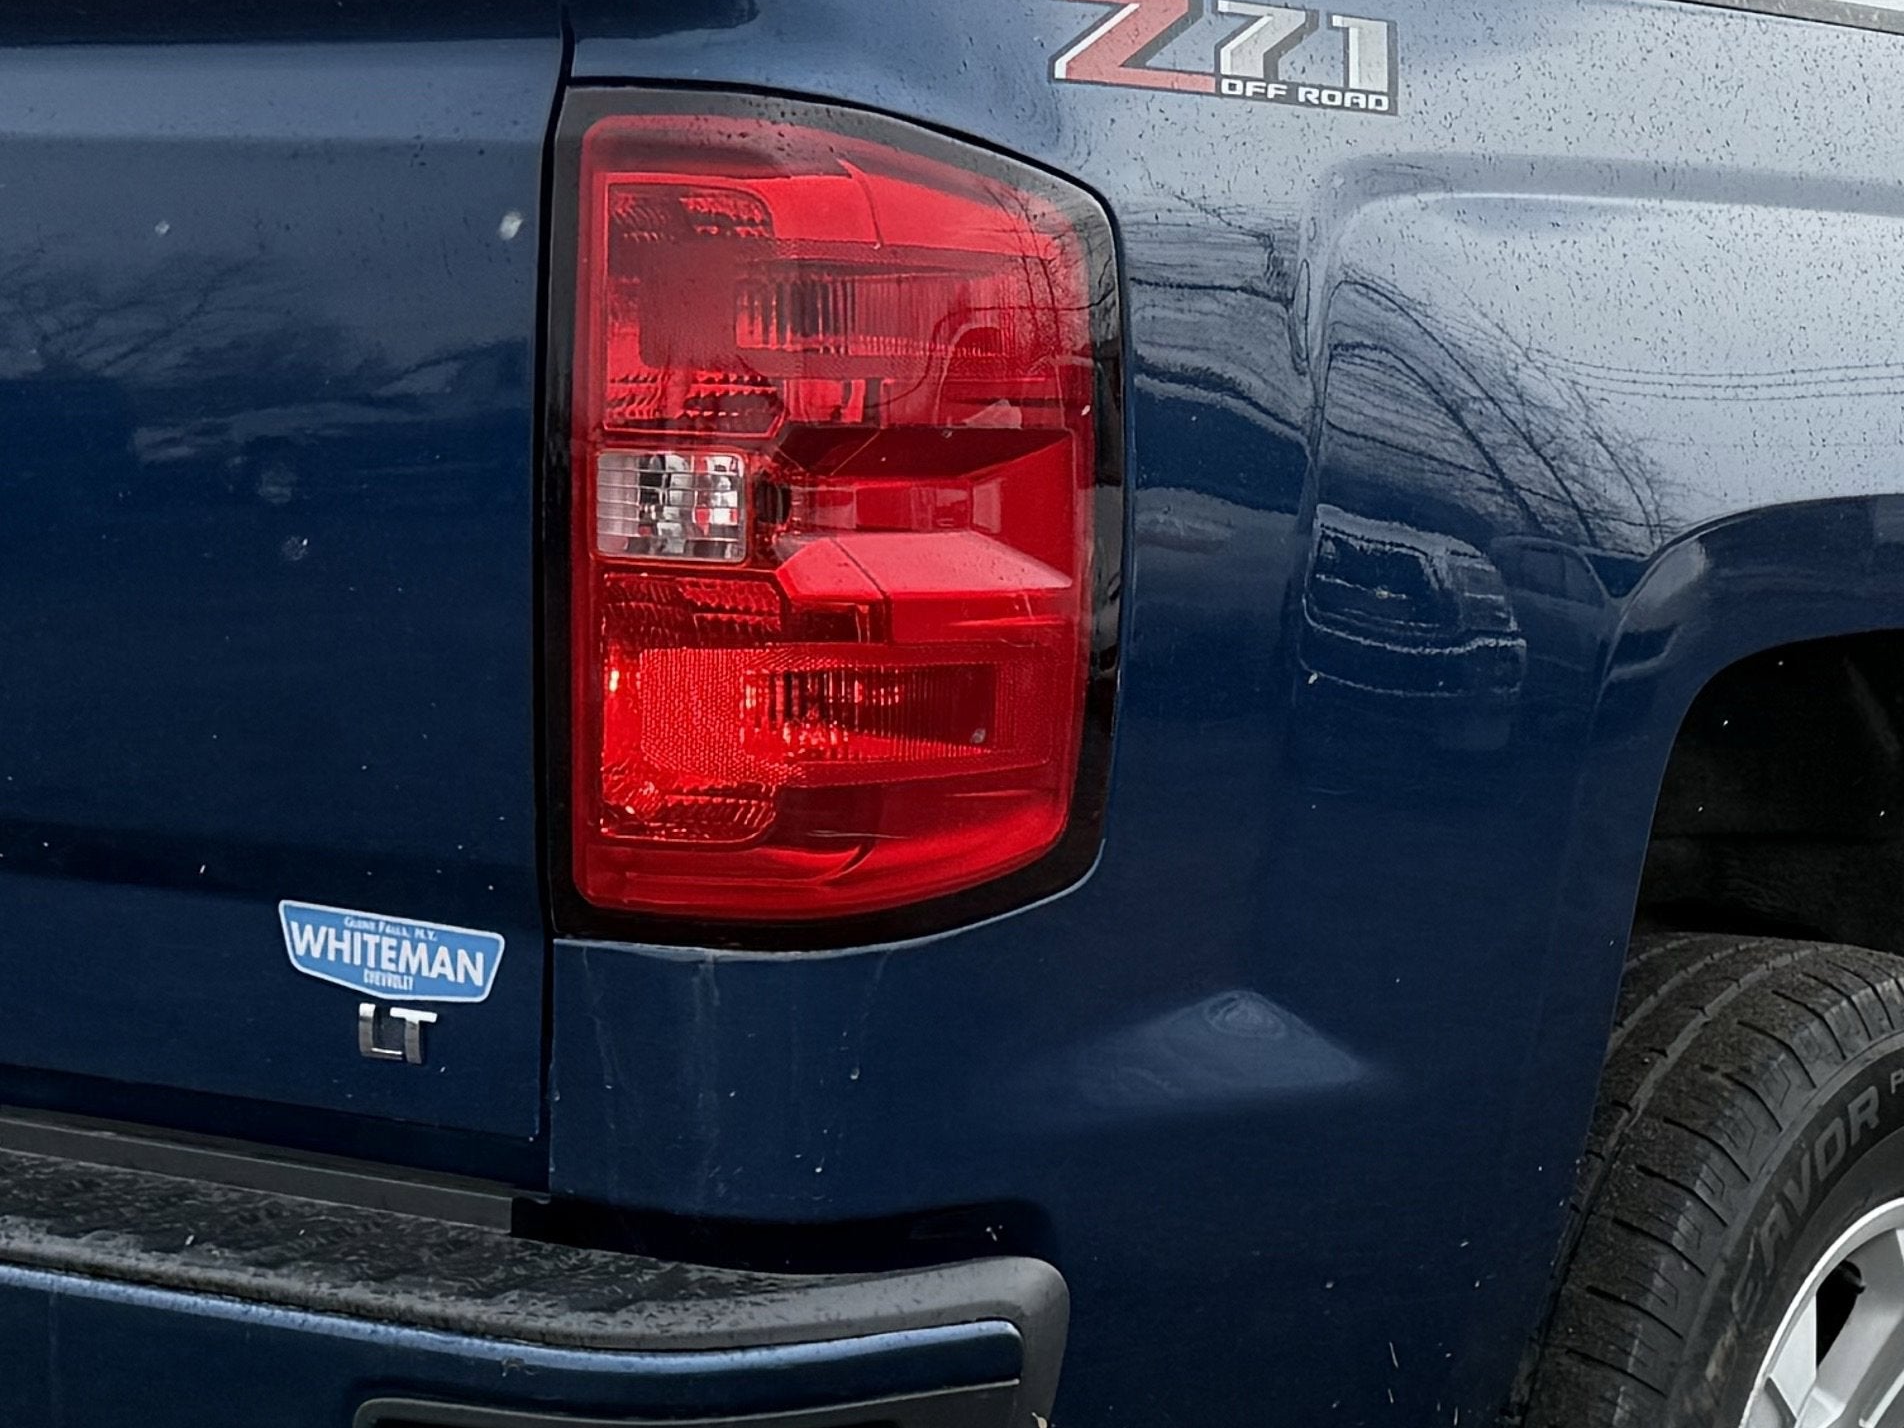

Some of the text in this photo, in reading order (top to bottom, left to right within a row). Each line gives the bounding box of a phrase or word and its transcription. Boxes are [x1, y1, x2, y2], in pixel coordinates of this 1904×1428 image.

[1220, 77, 1390, 113] OFF ROAD
[290, 921, 485, 987] WHITEMAN
[358, 1003, 438, 1065] LT
